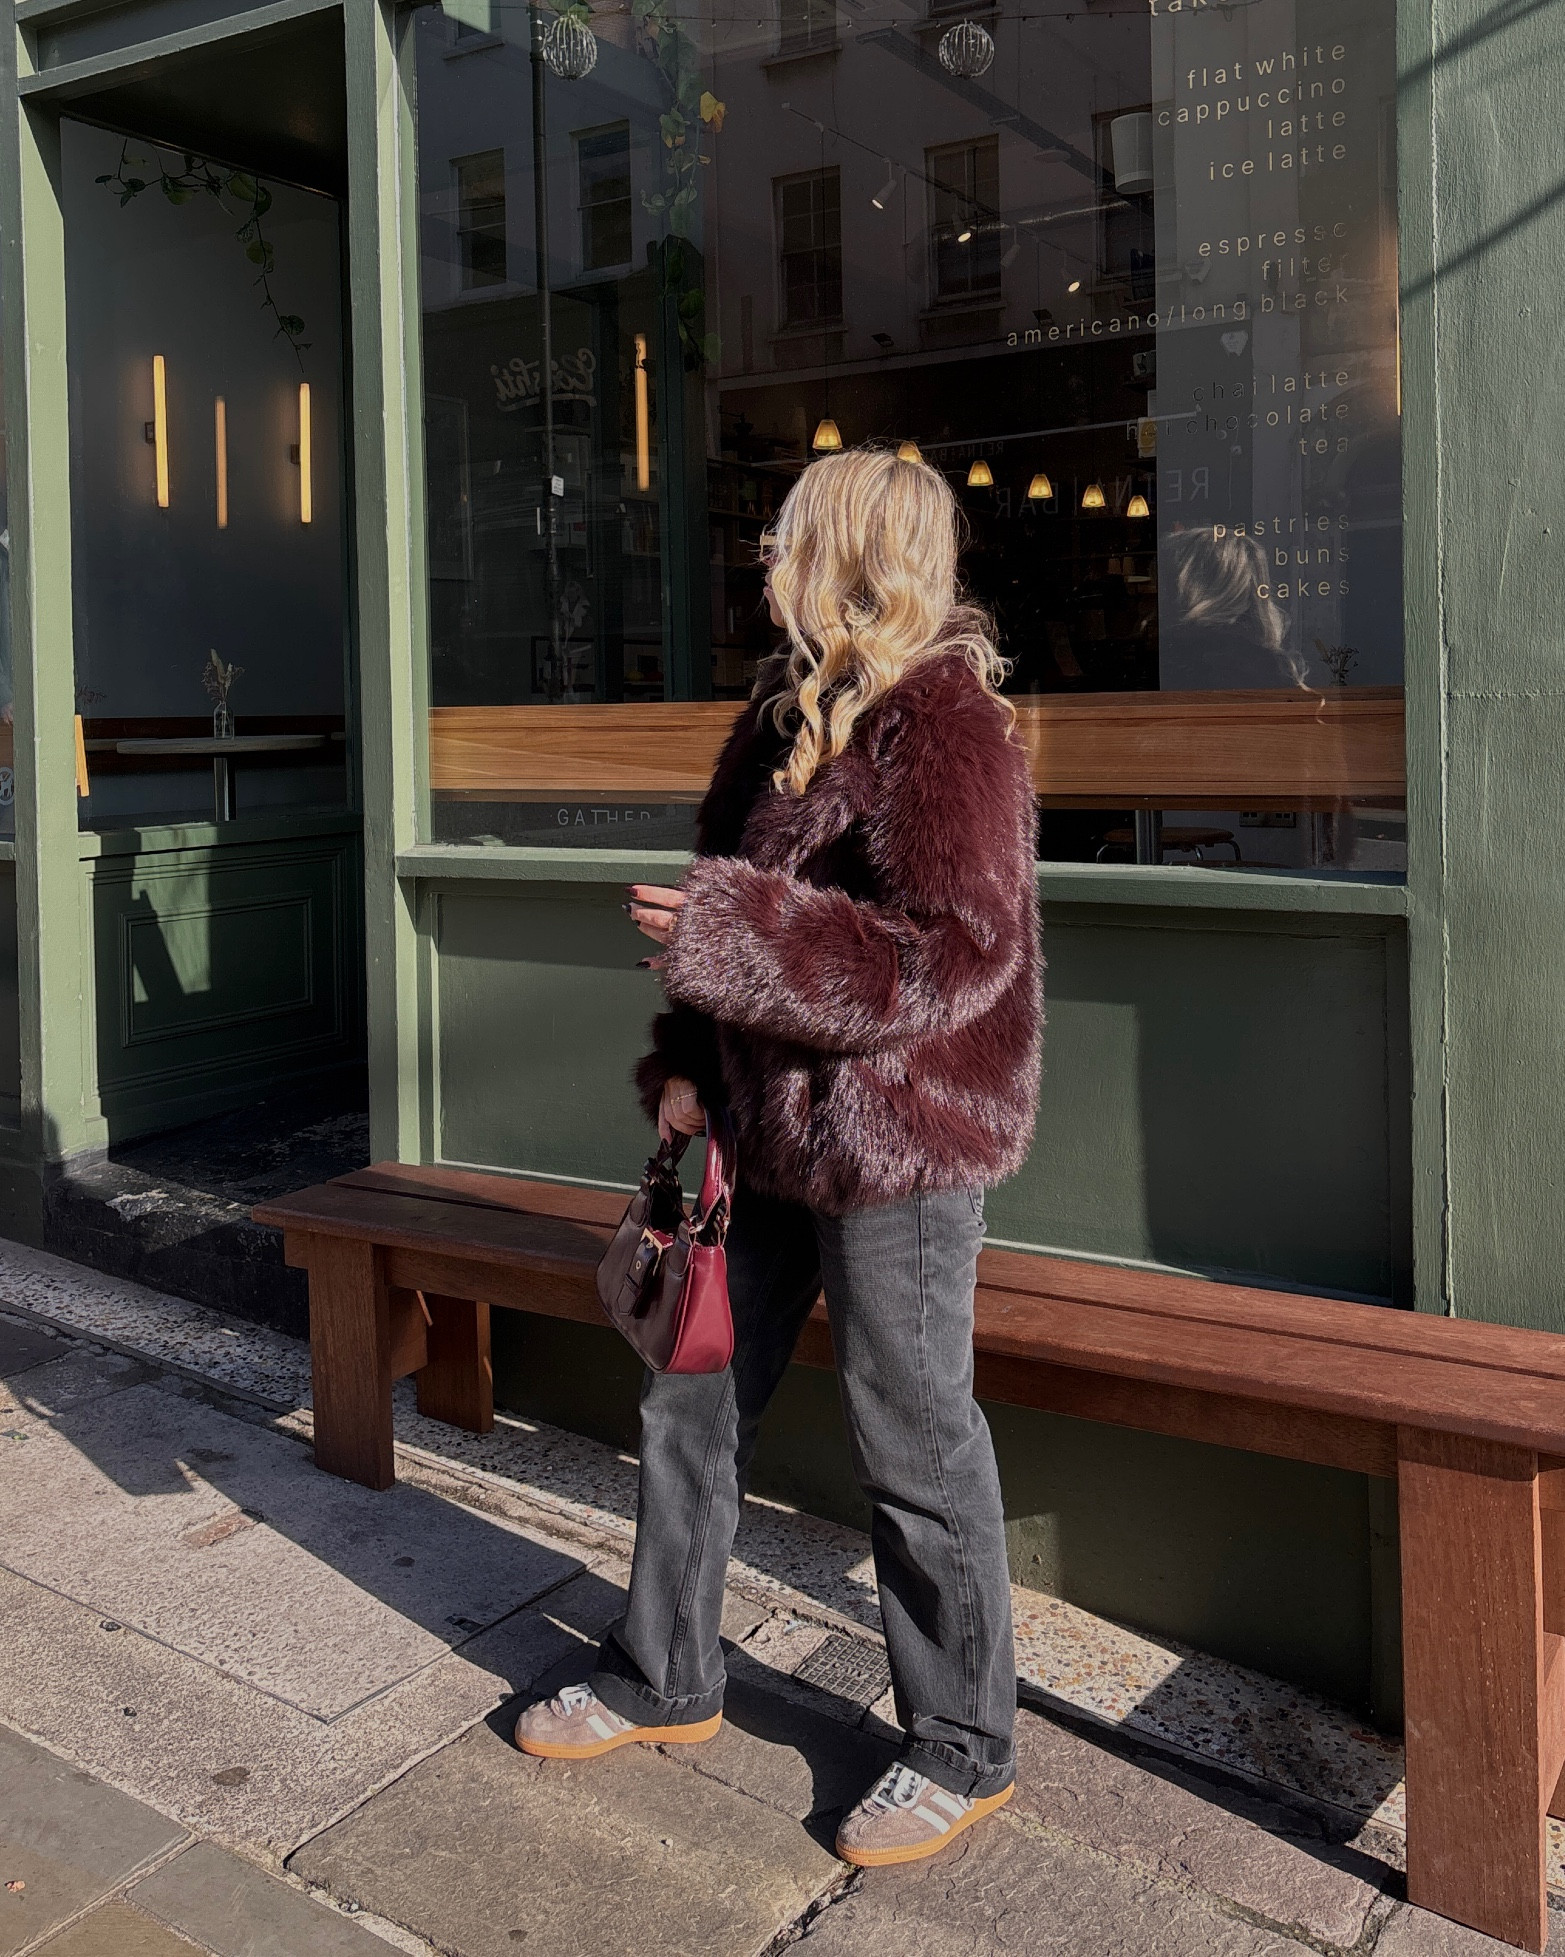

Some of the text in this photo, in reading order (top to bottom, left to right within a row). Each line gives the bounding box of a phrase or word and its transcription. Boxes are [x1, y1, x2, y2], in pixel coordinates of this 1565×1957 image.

[1187, 44, 1345, 89] flat white
[1157, 78, 1345, 124] cappuccino
[1267, 110, 1345, 138] latte
[1210, 143, 1346, 181] ice latte
[1198, 222, 1346, 257] espresso
[1006, 285, 1349, 347] americano/long black
[1192, 371, 1349, 402] chai latte
[1185, 404, 1349, 434] chocolate
[1299, 436, 1349, 456] tea
[1213, 512, 1349, 543] pastries
[1275, 547, 1350, 566] buns
[1256, 578, 1351, 599] cakes
